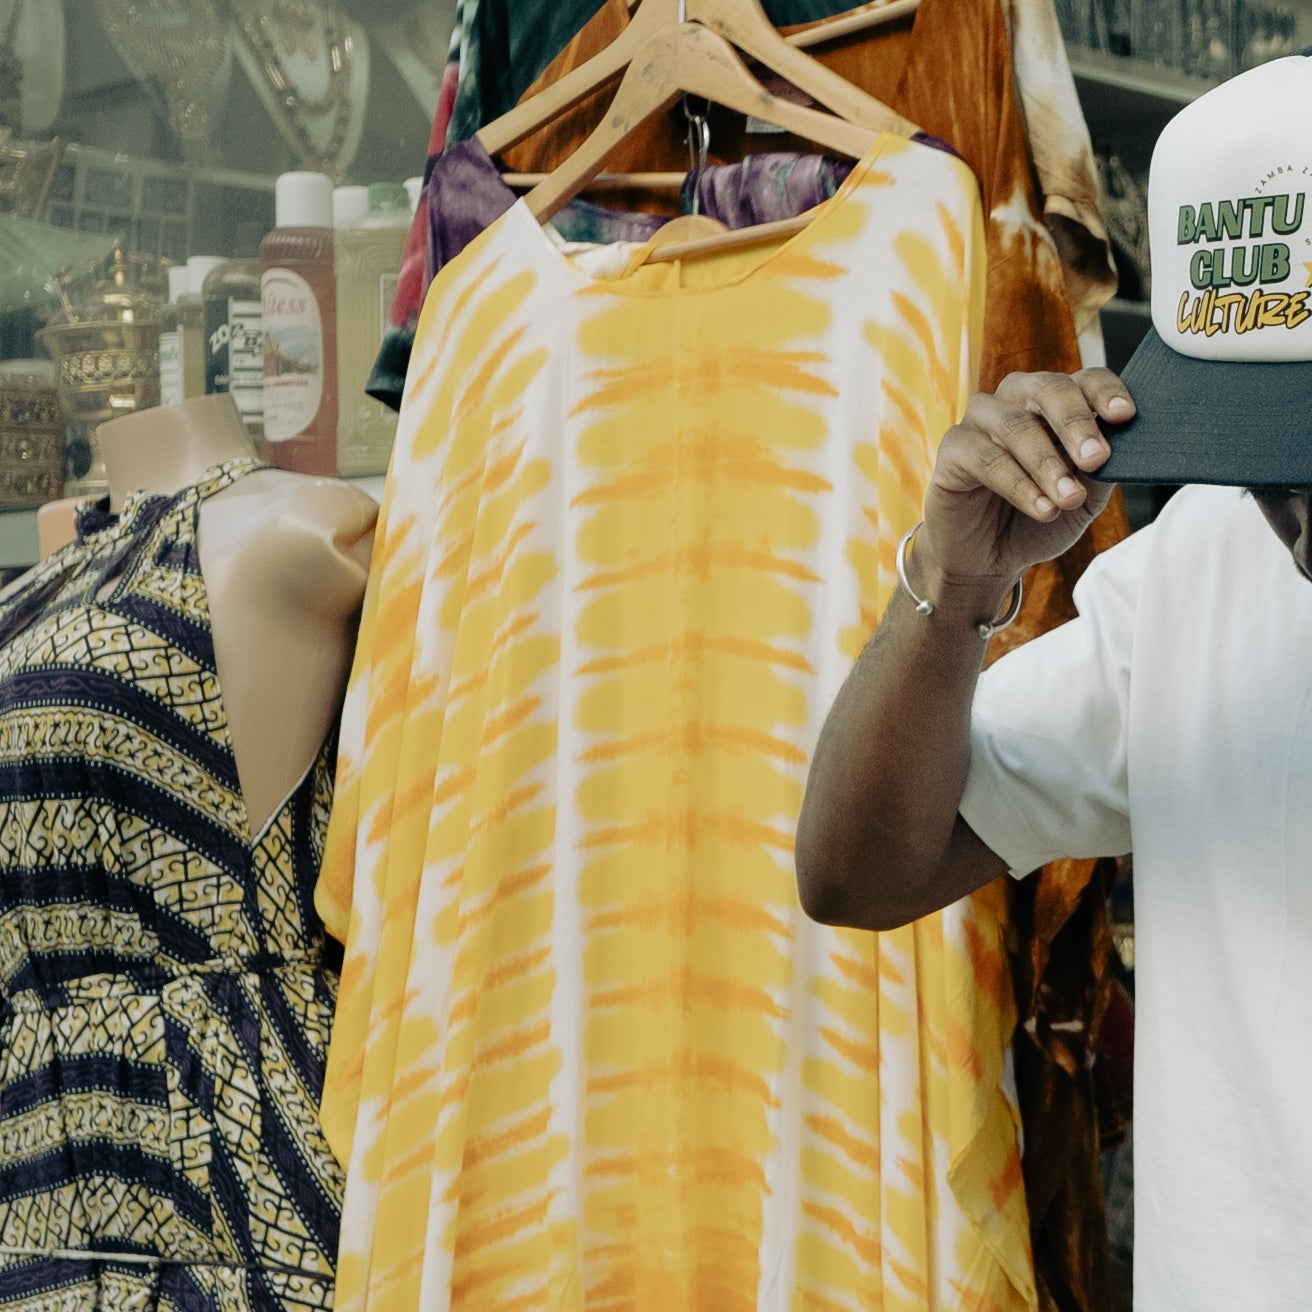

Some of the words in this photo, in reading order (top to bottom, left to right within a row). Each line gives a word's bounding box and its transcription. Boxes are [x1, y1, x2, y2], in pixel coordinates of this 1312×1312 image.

[1254, 164, 1294, 194] ZAMBA
[1177, 192, 1306, 246] BANTU
[1189, 242, 1291, 291] CLUB
[1176, 288, 1312, 338] CULTURE
